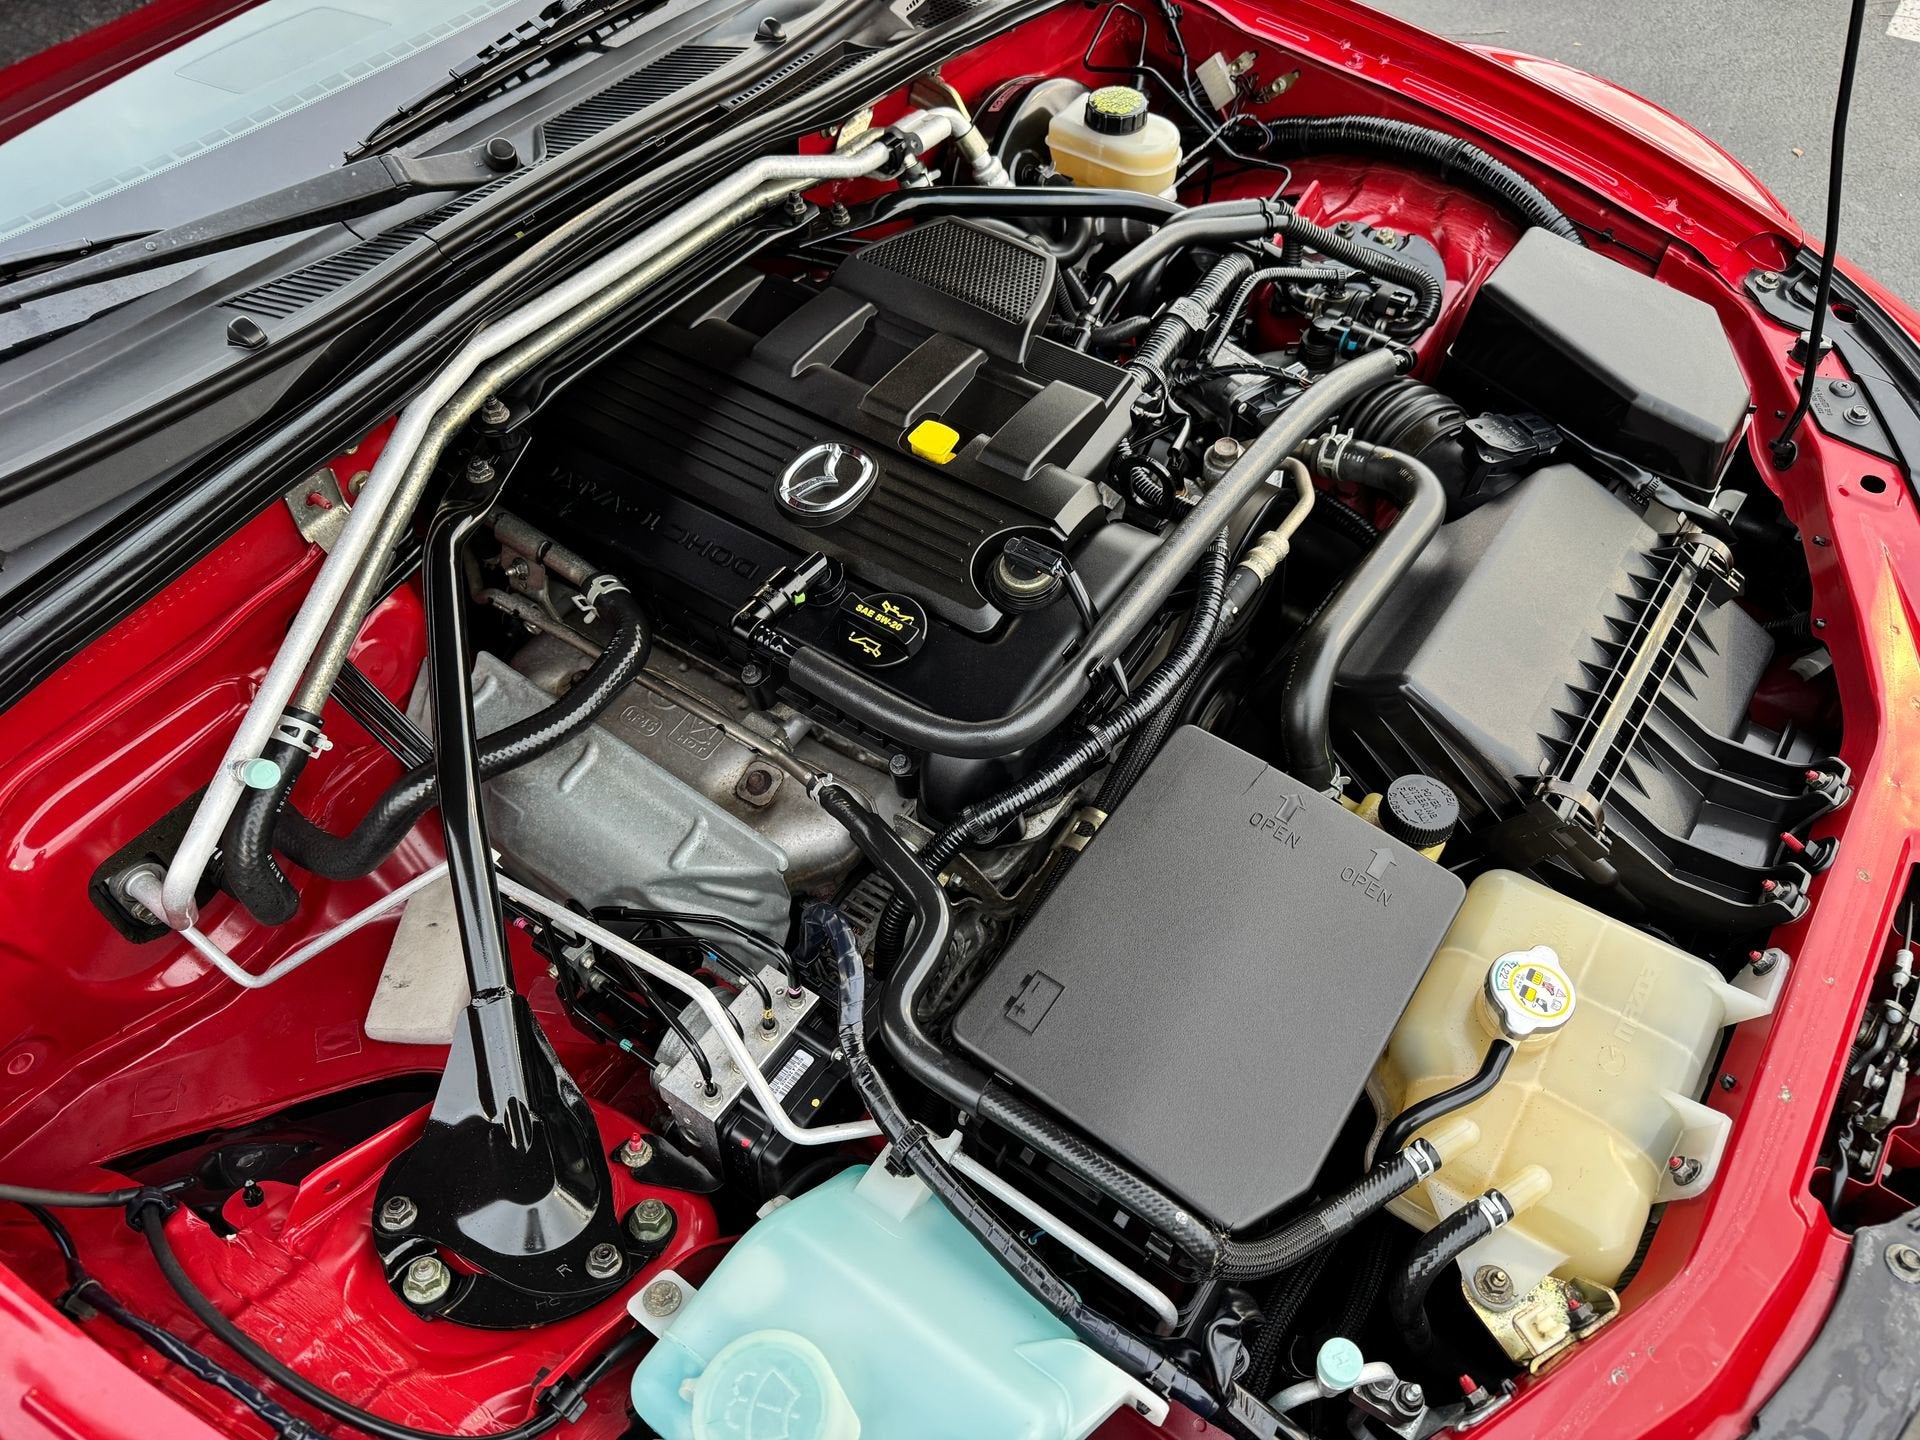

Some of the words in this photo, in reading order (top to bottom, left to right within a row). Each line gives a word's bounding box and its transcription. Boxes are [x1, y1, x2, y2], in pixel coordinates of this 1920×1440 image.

[662, 522, 761, 580] DOHC
[855, 603, 876, 618] SAE
[874, 613, 903, 631] 5W-20
[1249, 811, 1302, 850] OPEN
[1340, 865, 1394, 908] OPEN
